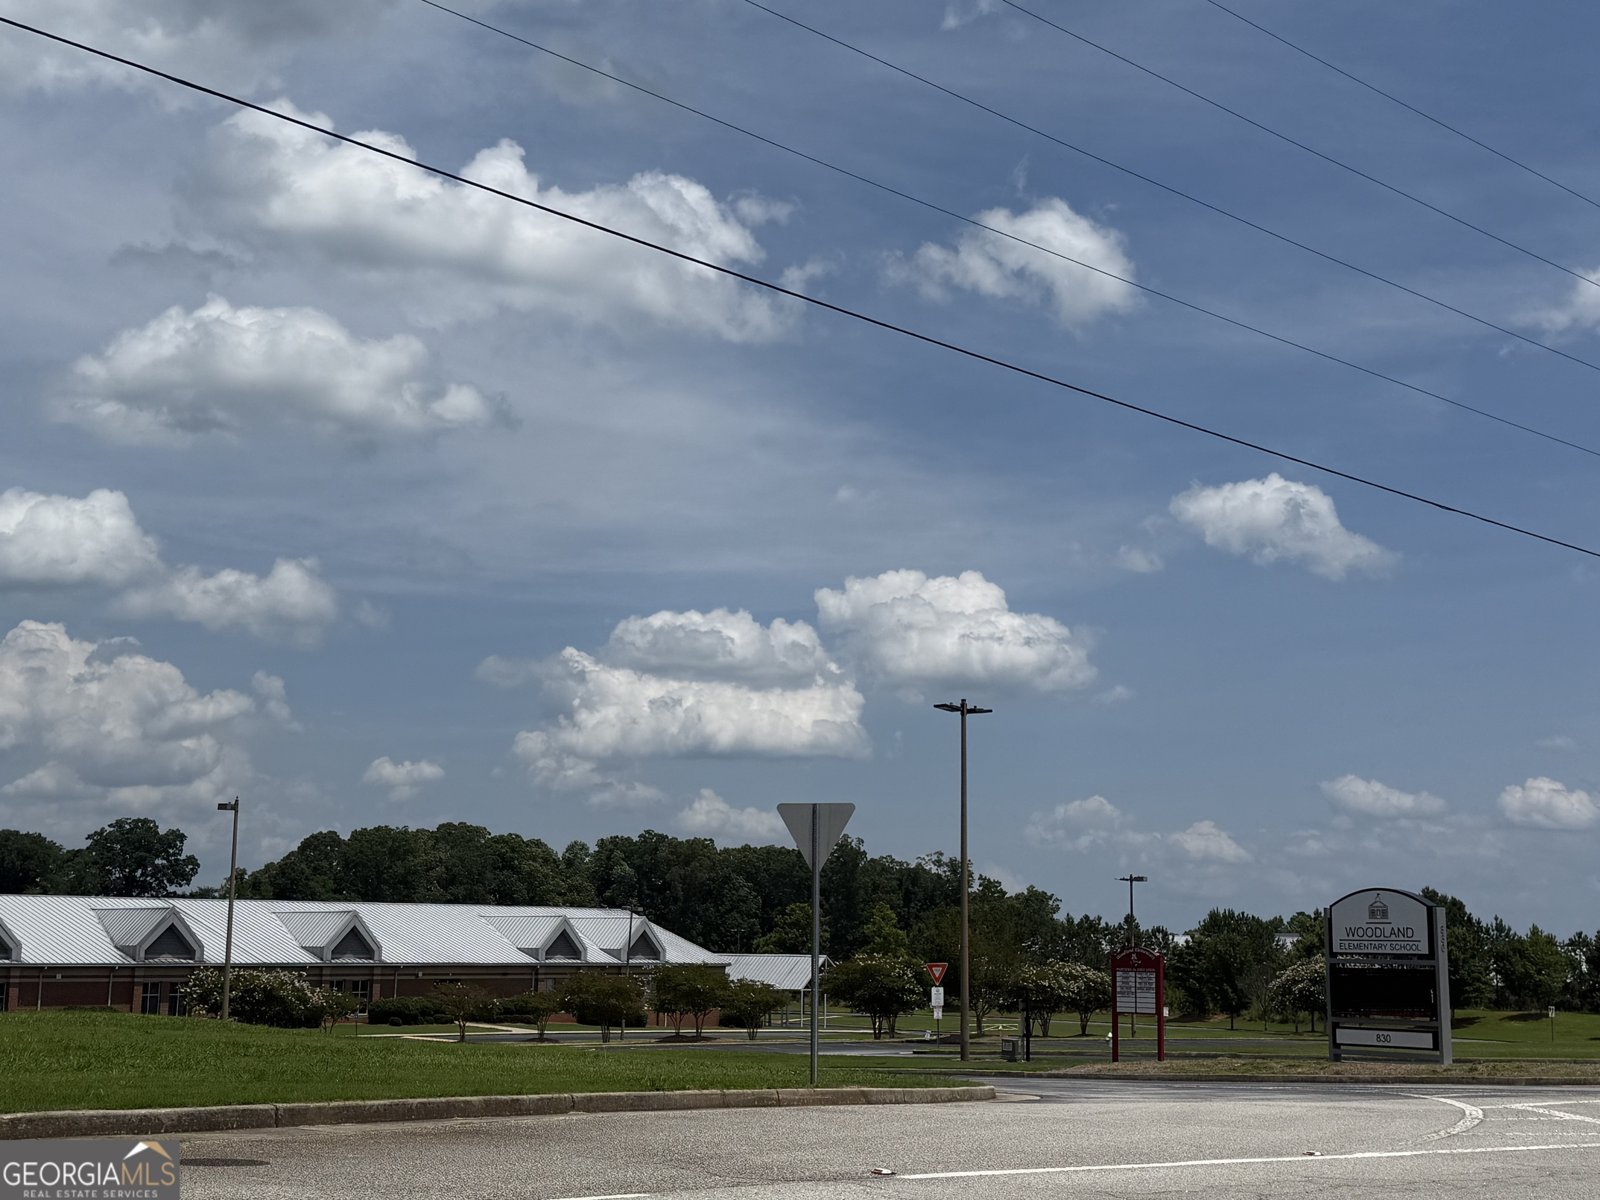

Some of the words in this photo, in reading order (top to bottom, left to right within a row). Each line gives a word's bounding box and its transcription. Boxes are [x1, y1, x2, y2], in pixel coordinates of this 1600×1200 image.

[1345, 926, 1414, 938] WOODLAND
[1339, 942, 1388, 951] ELEMENTARY
[1389, 943, 1421, 952] SCHOOL
[1376, 1033, 1391, 1043] 830
